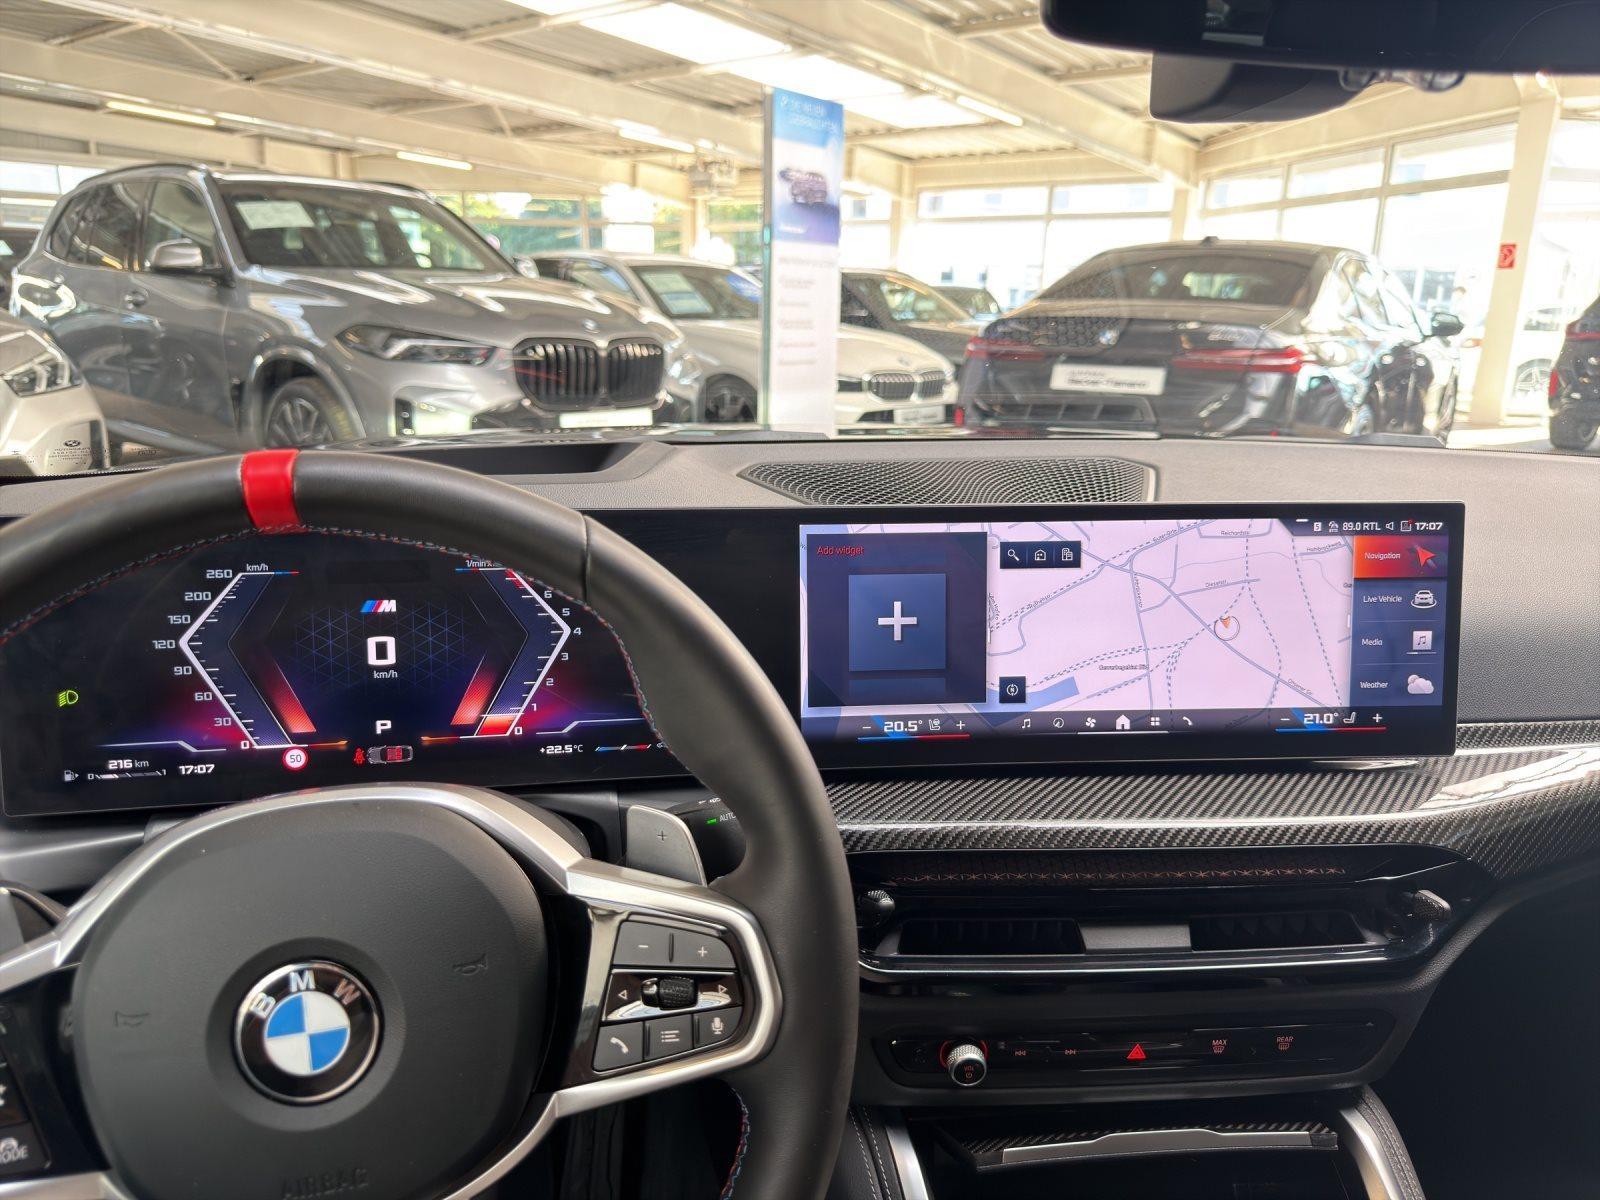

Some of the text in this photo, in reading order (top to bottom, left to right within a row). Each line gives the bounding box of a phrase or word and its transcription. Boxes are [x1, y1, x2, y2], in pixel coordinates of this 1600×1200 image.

[1342, 521, 1381, 531] 89.0 RTL
[1414, 521, 1443, 531] 17:07
[817, 545, 865, 557] Add widget
[1364, 551, 1401, 562] Navigation
[245, 562, 269, 572] km/h
[205, 568, 233, 579] 260
[184, 591, 212, 601] 200
[543, 590, 553, 599] 6
[1362, 593, 1403, 603] Live Vehicle
[562, 608, 570, 616] 5
[167, 614, 191, 625] 150
[573, 627, 582, 636] 4
[151, 639, 176, 649] 120
[1361, 637, 1384, 646] Media
[366, 635, 396, 666] 0
[561, 652, 569, 661] 3
[173, 665, 193, 676] 90
[373, 669, 398, 679] km/h
[545, 678, 555, 687] 2
[1359, 680, 1389, 690] Weather
[194, 691, 213, 702] 60
[531, 703, 538, 711] 1
[213, 716, 232, 727] 30
[375, 719, 392, 734] P
[514, 726, 523, 735] 0
[240, 740, 250, 750] 0
[289, 754, 303, 763] 50
[108, 759, 149, 769] 216 km
[178, 763, 215, 775] 17:07
[250, 969, 362, 1020] BMW
[1276, 1035, 1294, 1043] REAR
[0, 1144, 29, 1164] ODE
